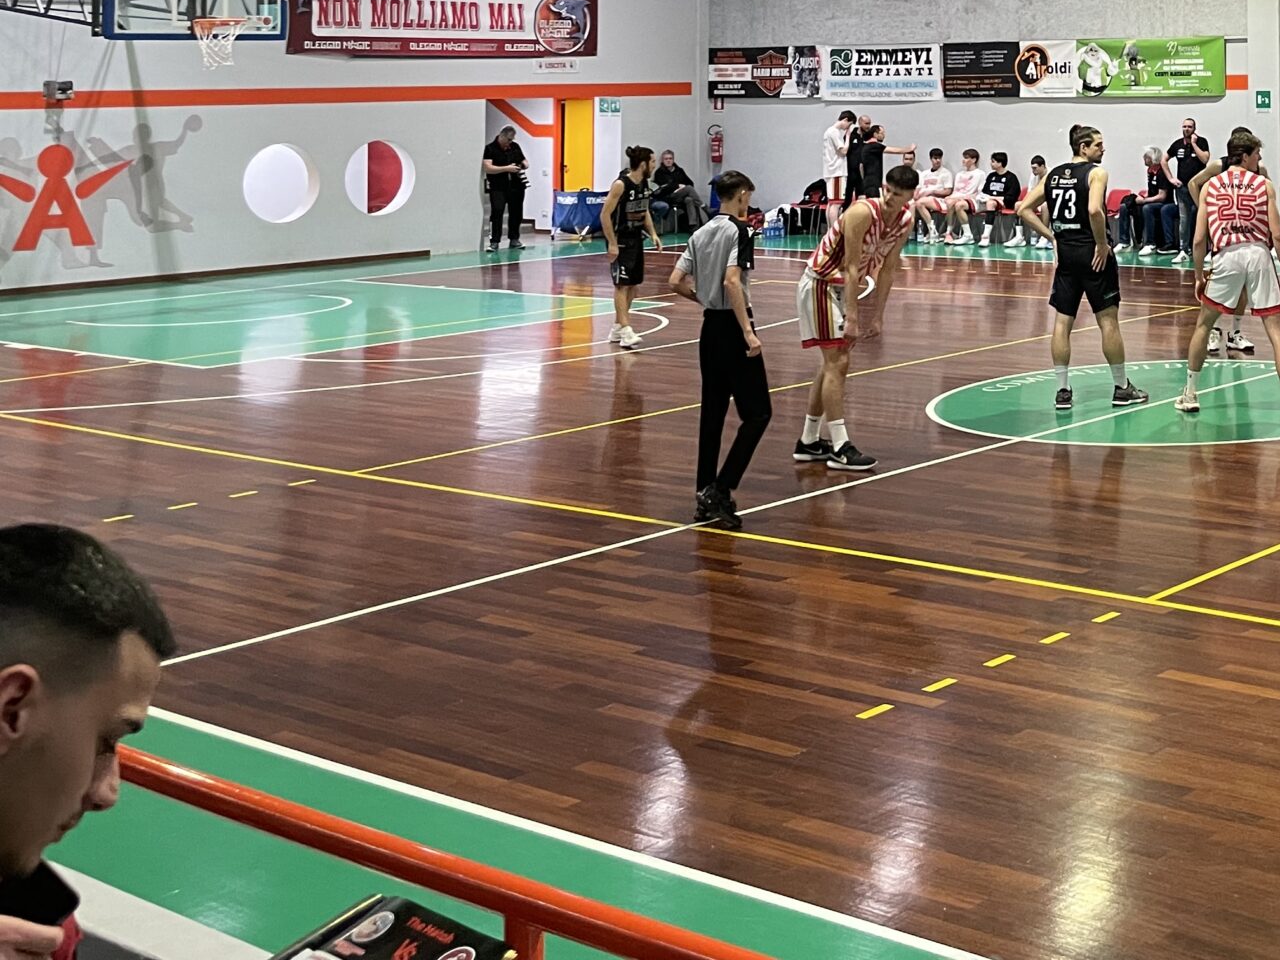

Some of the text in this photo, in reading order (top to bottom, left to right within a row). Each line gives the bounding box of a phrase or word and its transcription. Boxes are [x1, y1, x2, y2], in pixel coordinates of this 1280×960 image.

[488, 3, 525, 32] MAI
[855, 47, 932, 65] EMMEVI
[854, 67, 933, 76] IMPIANTI
[629, 189, 635, 200] 3
[1052, 189, 1077, 220] 73
[1215, 193, 1258, 222] 25
